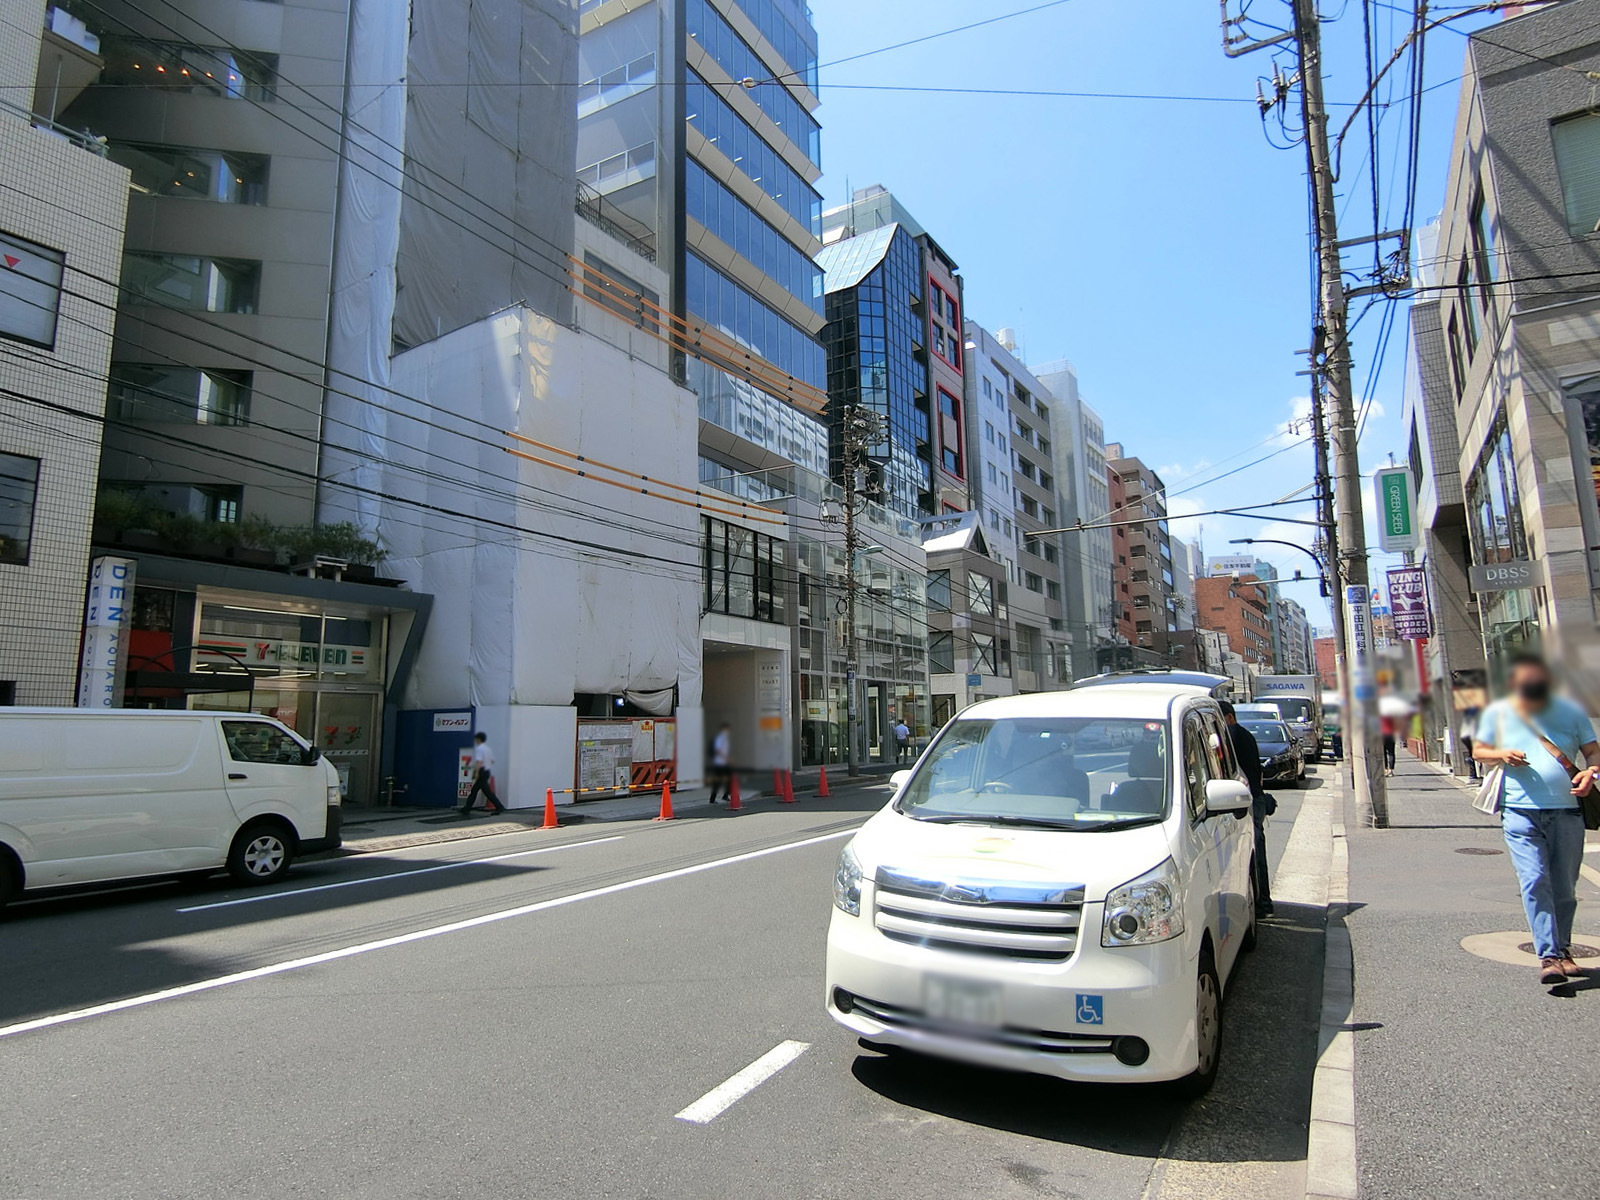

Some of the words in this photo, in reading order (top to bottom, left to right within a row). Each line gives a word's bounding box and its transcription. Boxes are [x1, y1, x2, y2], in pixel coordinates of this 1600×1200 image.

[1390, 486, 1400, 513] GREEN
[1392, 513, 1404, 534] SEED
[1388, 572, 1420, 584] WING
[1486, 566, 1530, 581] DBSS
[107, 564, 128, 622] DEN
[1390, 583, 1422, 594] CLUB
[102, 633, 119, 707] AQUARO
